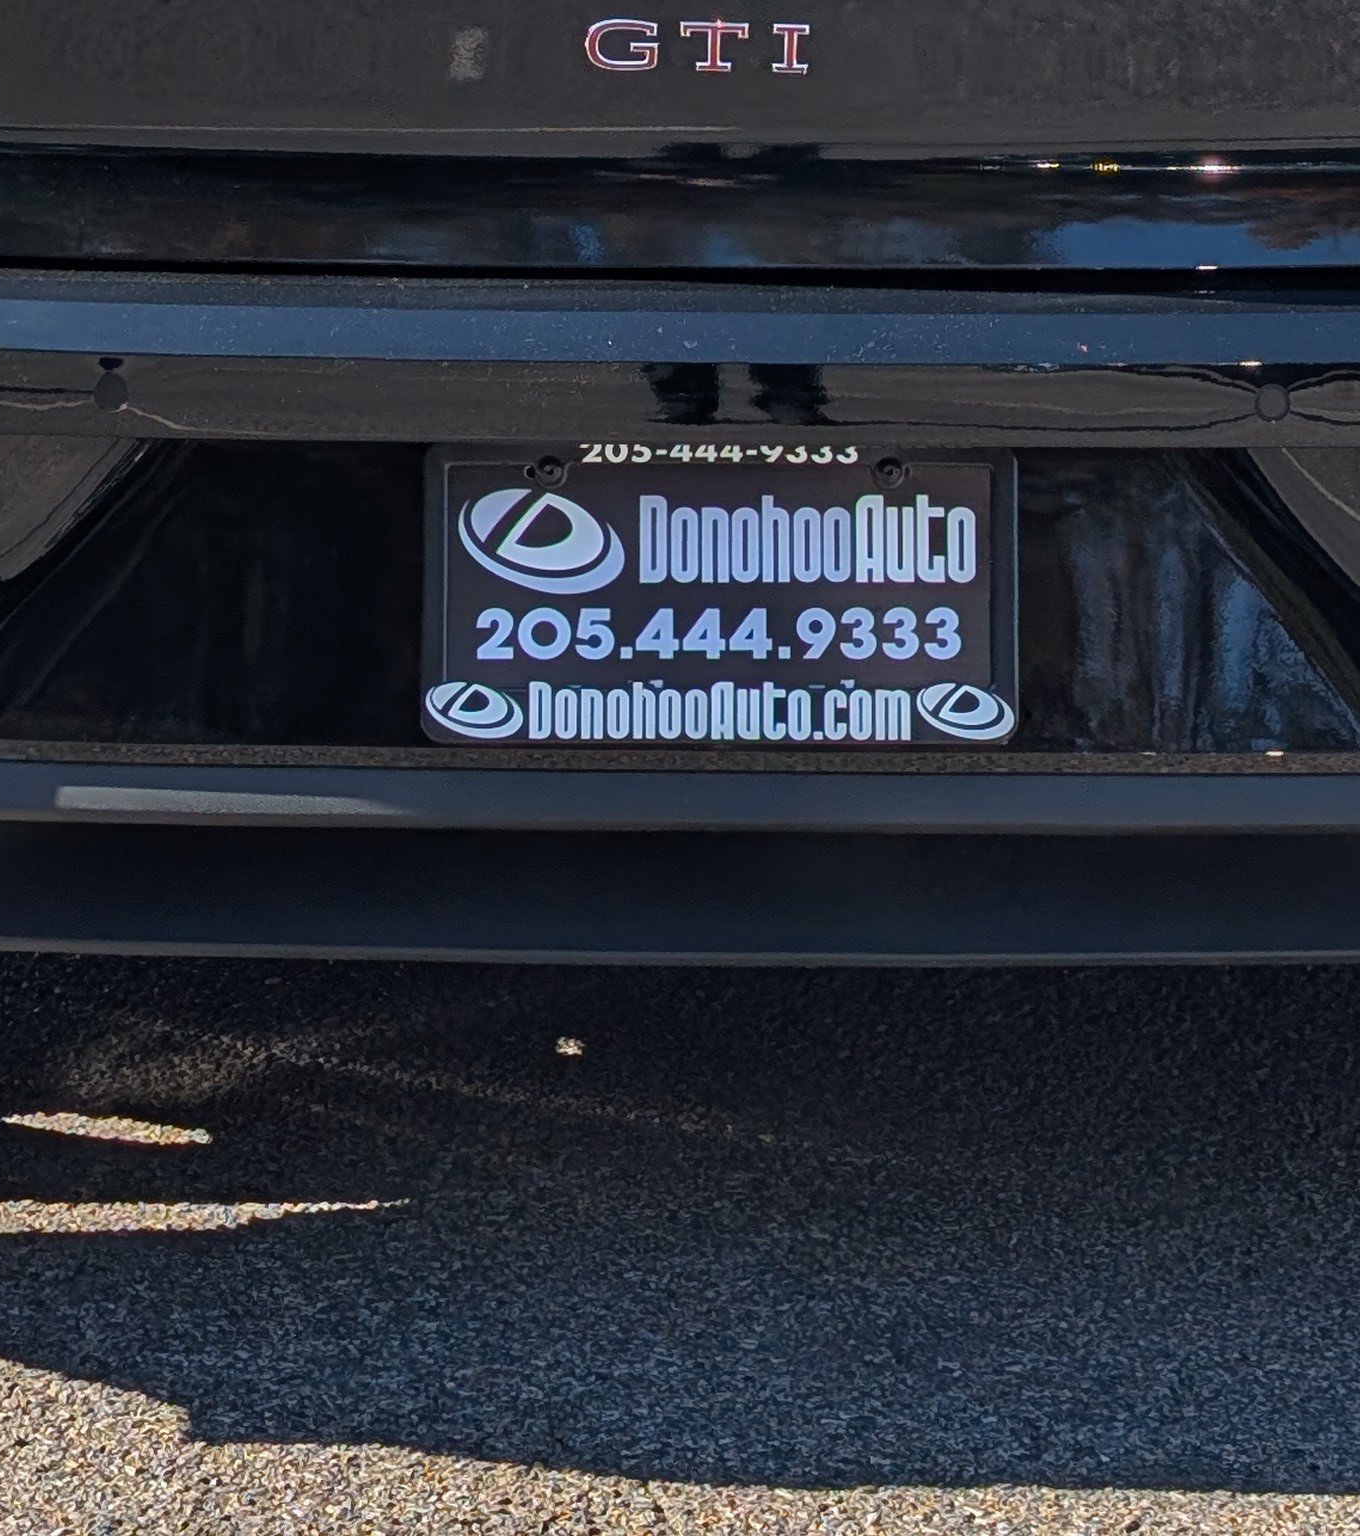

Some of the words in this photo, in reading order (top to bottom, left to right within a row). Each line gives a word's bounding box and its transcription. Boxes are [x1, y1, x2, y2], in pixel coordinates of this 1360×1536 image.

[585, 18, 811, 75] GTI
[638, 493, 977, 584] DonohooAuto
[475, 607, 962, 660] 205.444.9333
[528, 680, 911, 741] DonohooAuto.com
